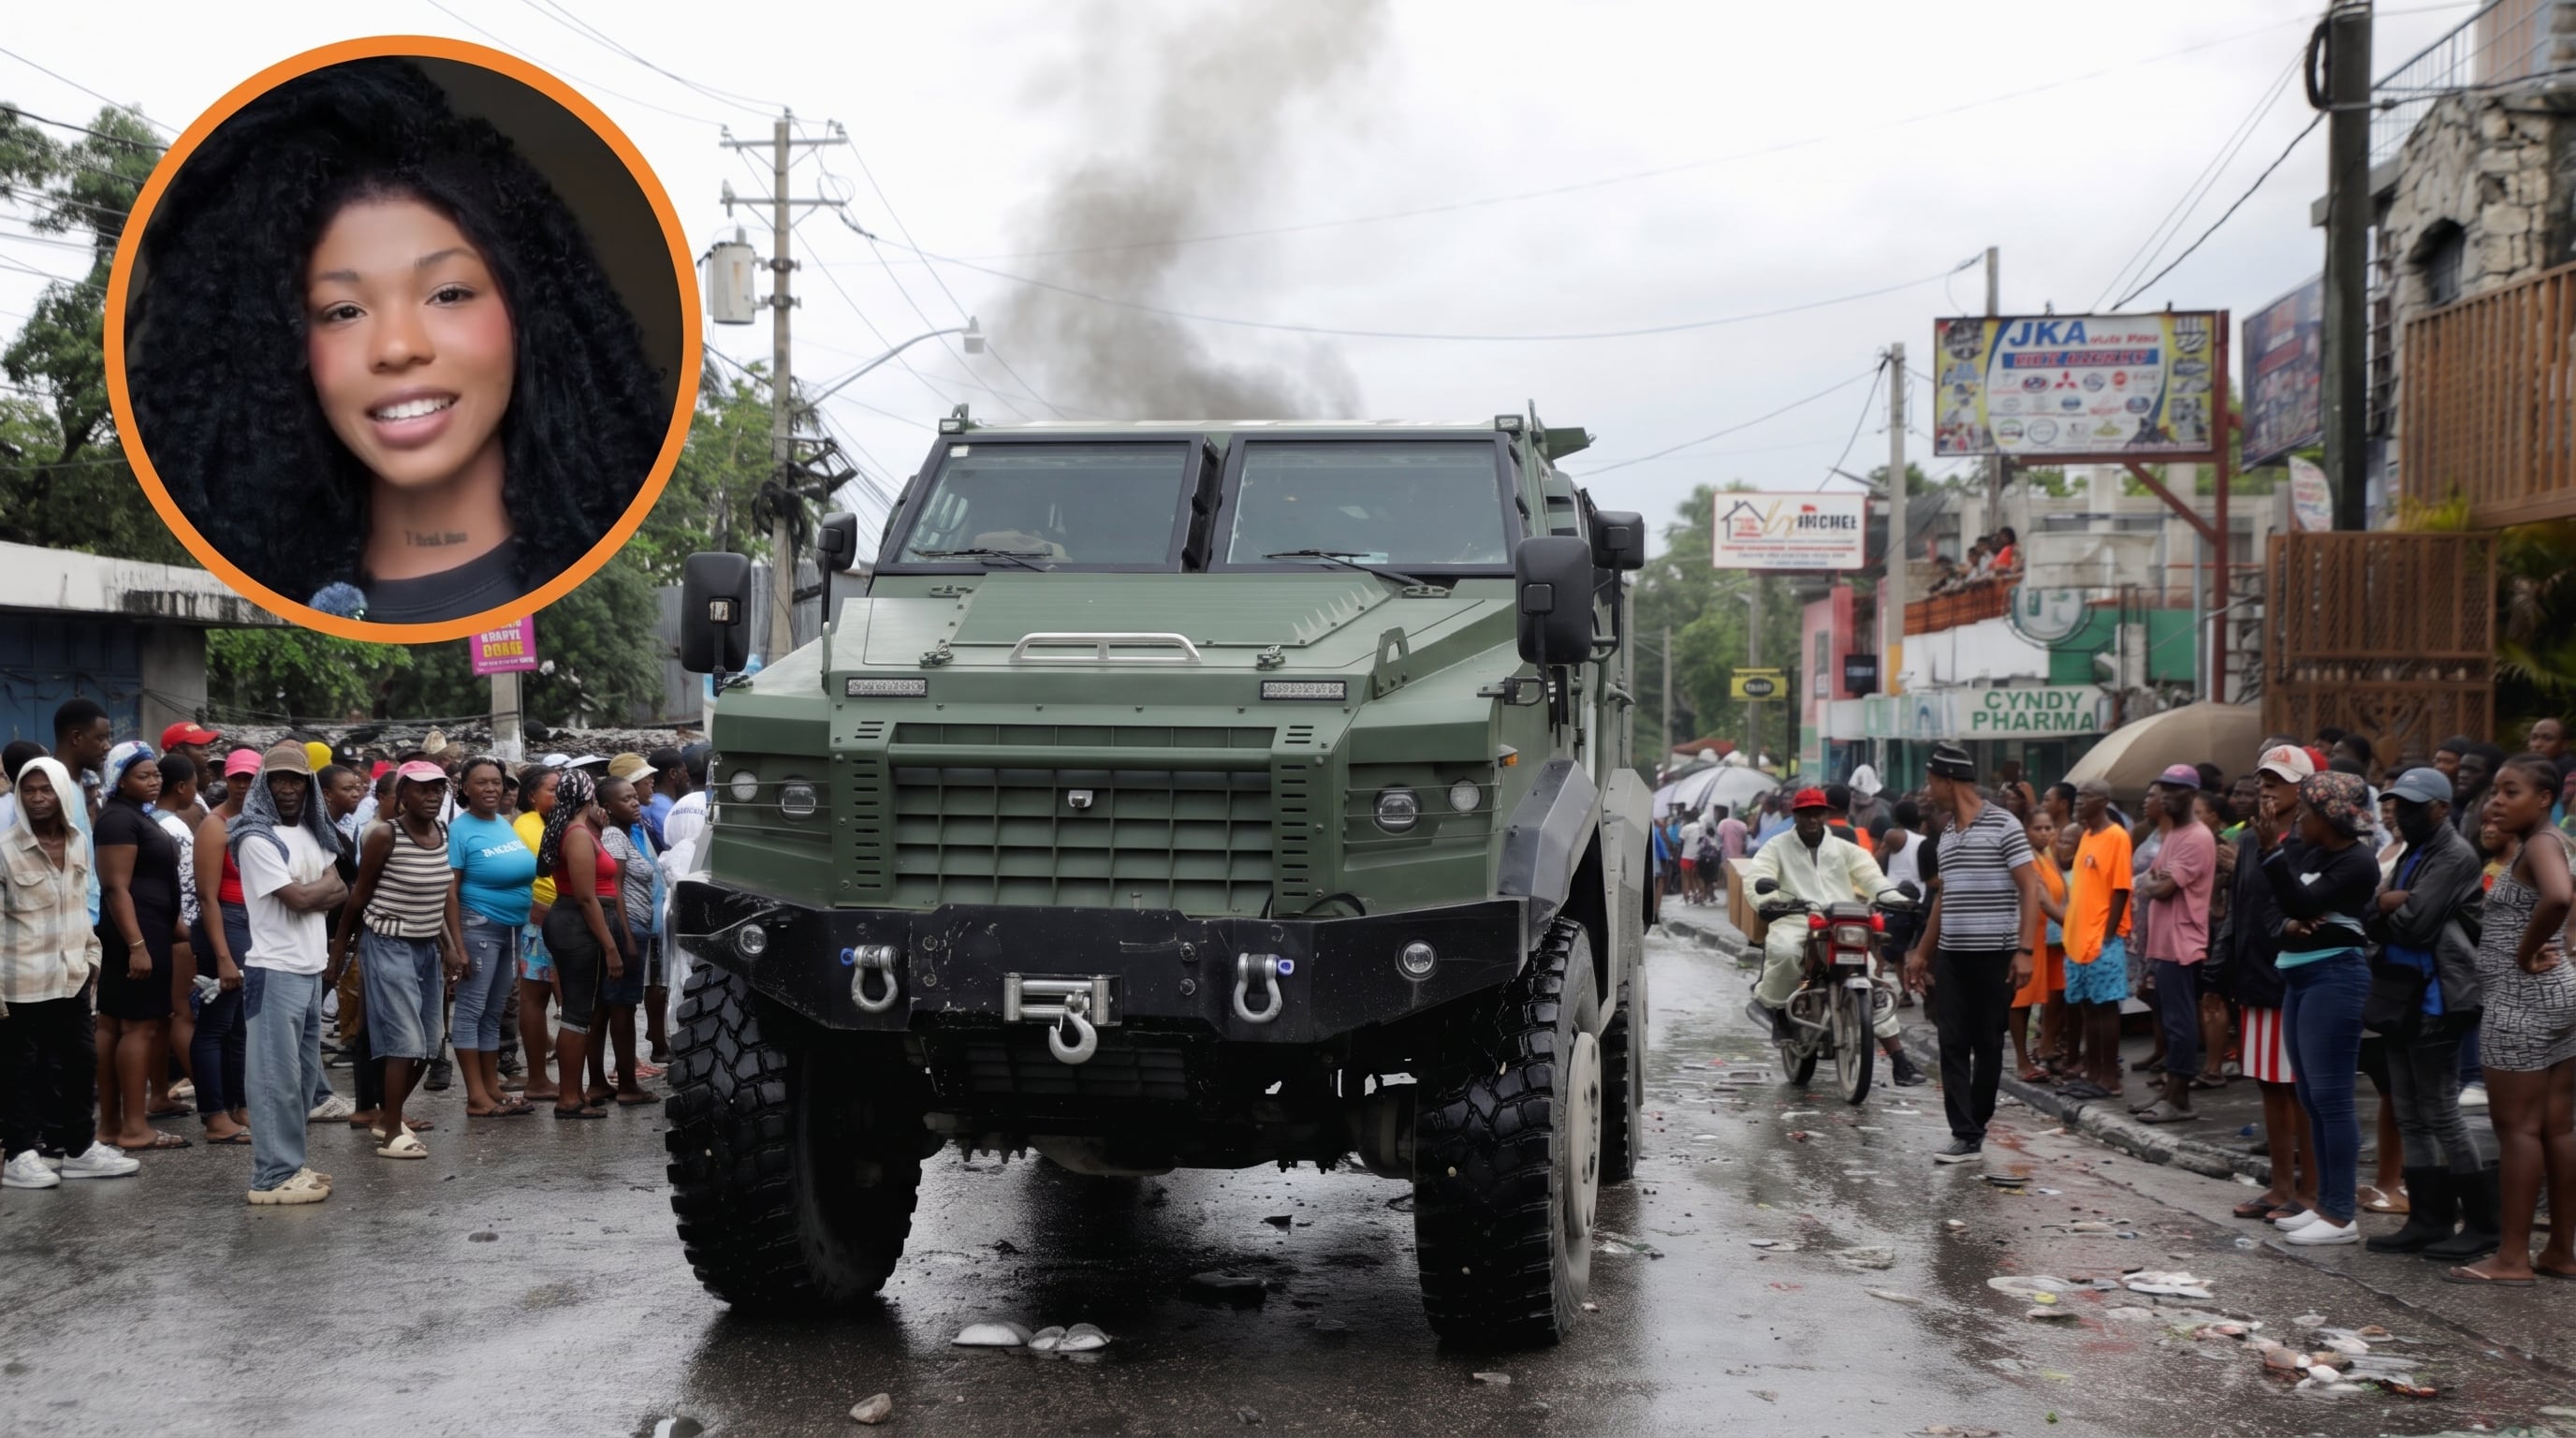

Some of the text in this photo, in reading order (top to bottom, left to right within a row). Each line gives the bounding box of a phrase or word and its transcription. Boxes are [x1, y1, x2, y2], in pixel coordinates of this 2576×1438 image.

[2009, 320, 2087, 346] JKA
[1984, 691, 2084, 710] CYNDY
[1972, 712, 2095, 730] PHARMA
